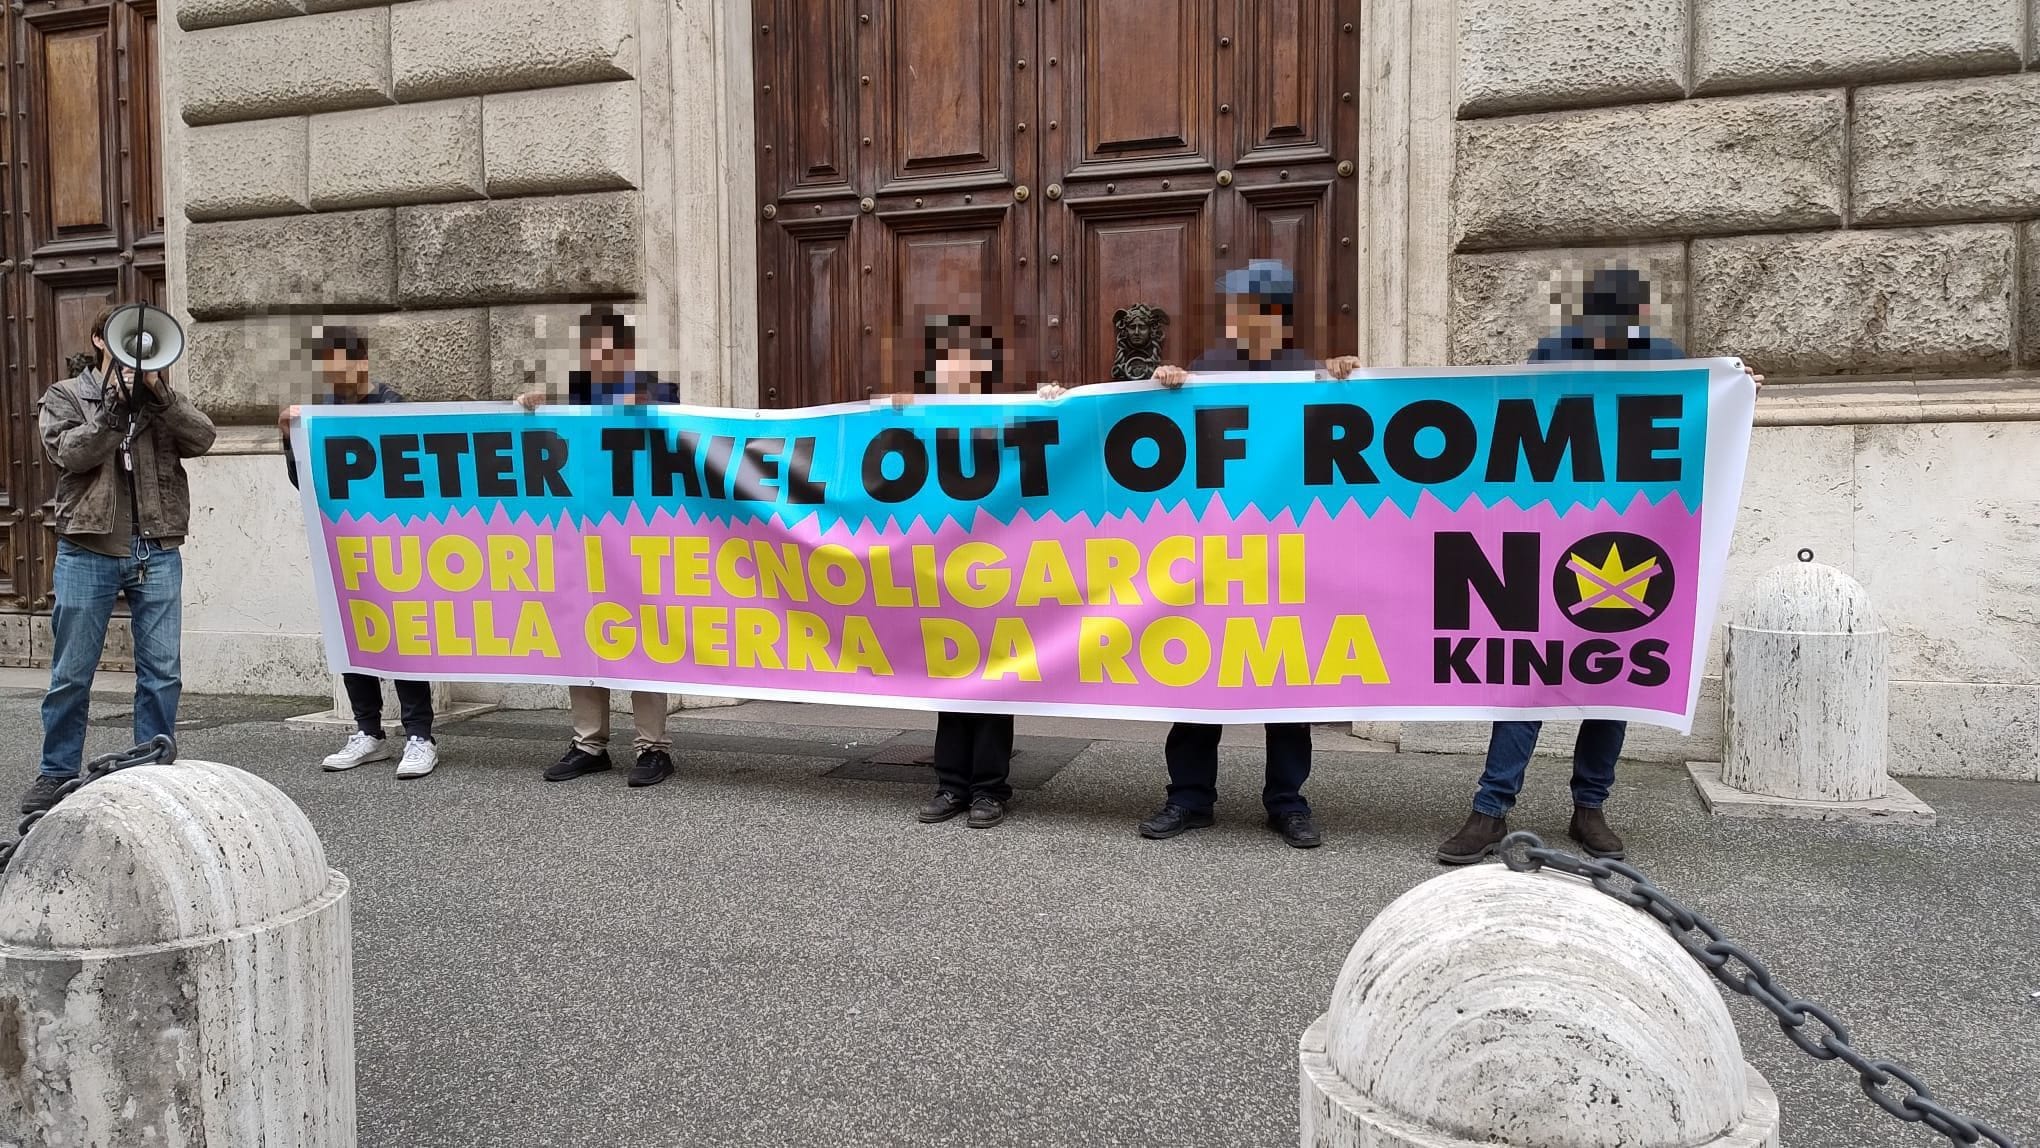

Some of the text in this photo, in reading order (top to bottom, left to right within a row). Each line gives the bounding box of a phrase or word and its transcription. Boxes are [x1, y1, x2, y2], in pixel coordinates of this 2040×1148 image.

[324, 394, 1684, 504] PETER THIEL OUT OF ROME
[336, 533, 1306, 607] FUORI I TECNOLIGARCHI
[350, 600, 1390, 688] DELLA GUERRA DA ROMA
[1433, 637, 1671, 686] KINGS
